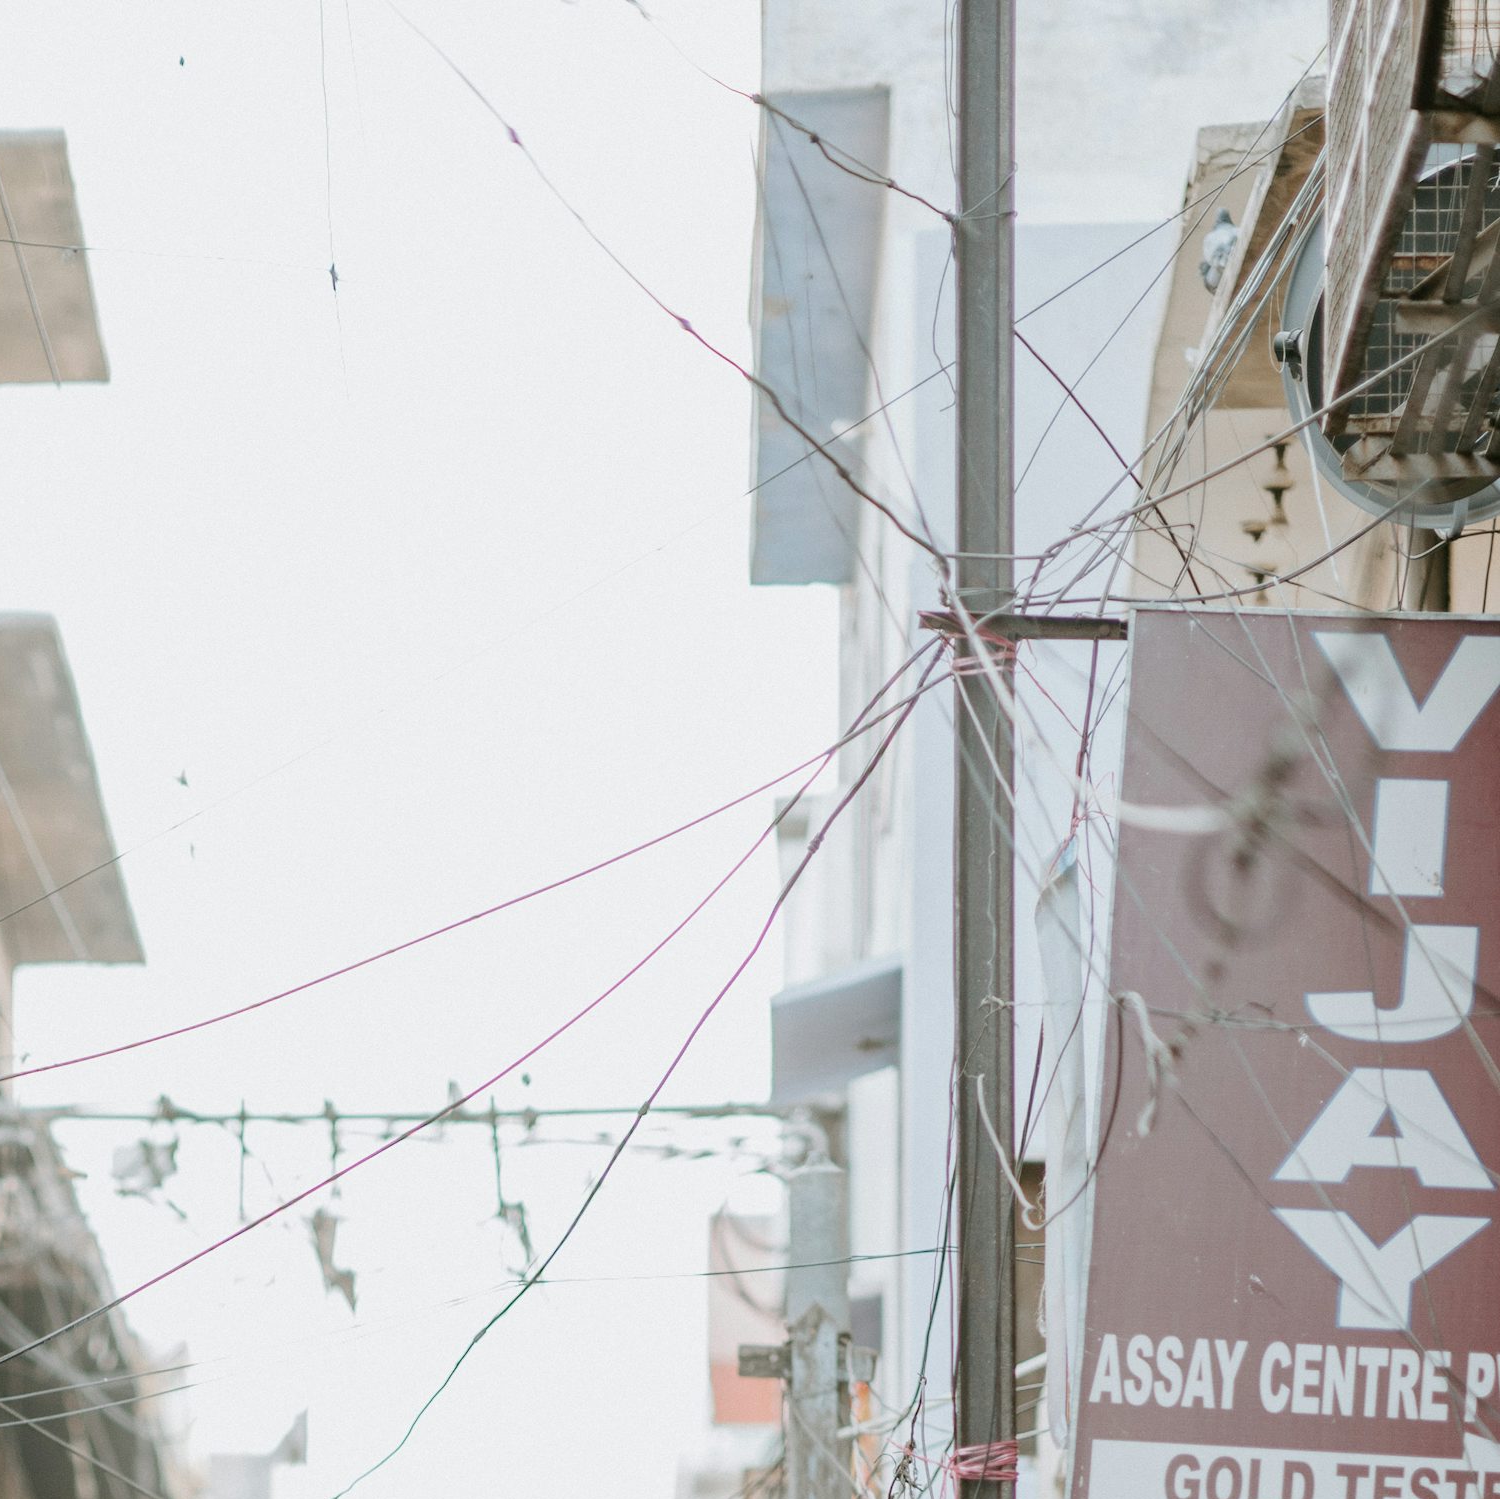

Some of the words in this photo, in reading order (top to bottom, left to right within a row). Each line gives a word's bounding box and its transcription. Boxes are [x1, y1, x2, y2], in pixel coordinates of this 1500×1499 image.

[1271, 631, 1500, 1330] VIJAY
[1089, 1333, 1248, 1410] ASSAY
[1260, 1342, 1451, 1422] CENTRE
